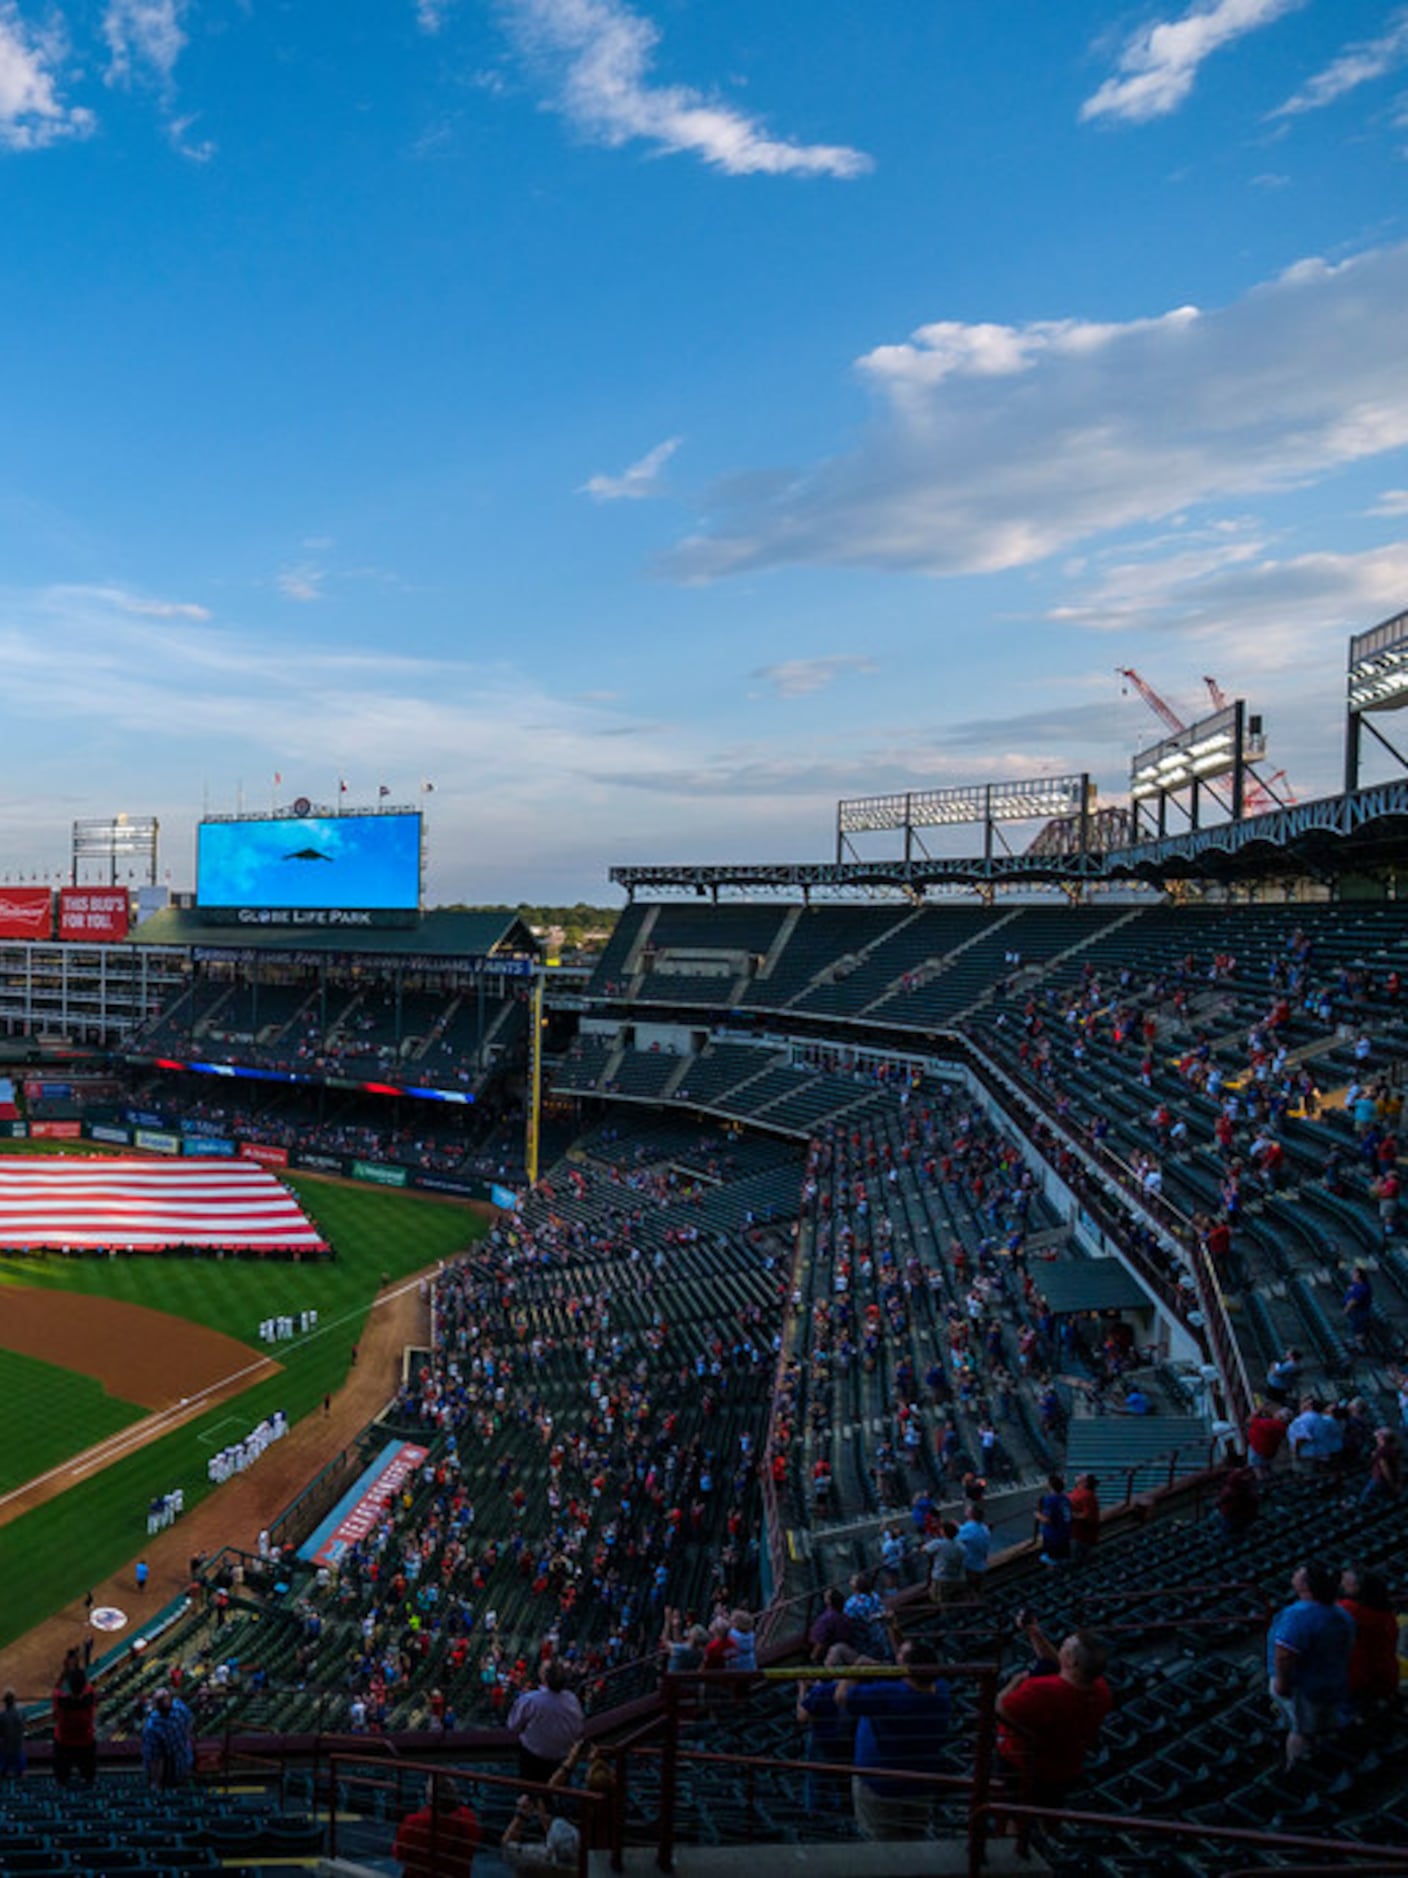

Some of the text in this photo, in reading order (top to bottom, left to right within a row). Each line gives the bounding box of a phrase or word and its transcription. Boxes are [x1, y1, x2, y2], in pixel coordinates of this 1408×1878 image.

[63, 896, 88, 911] THIS
[62, 913, 84, 928] FOR
[239, 908, 372, 924] GLOBE LIFE PARK
